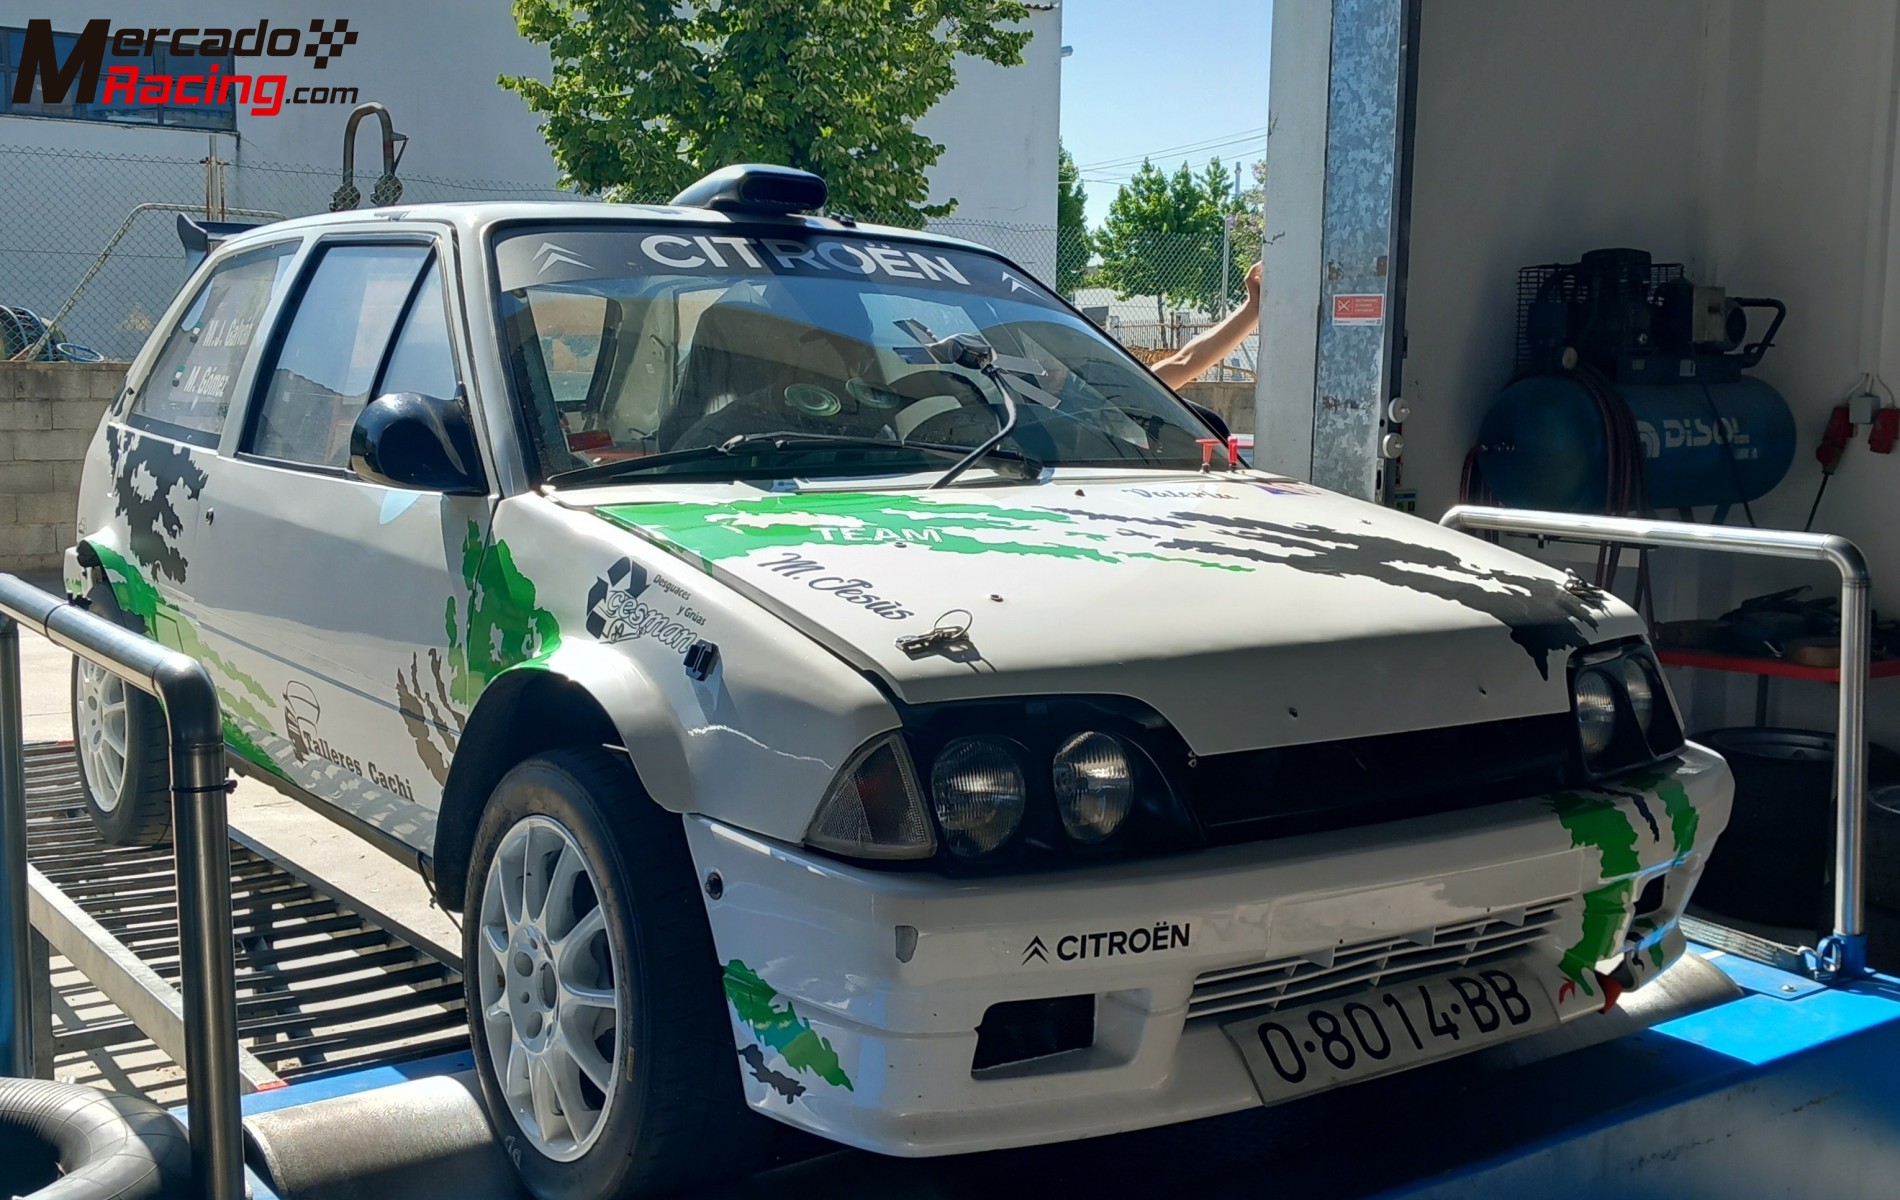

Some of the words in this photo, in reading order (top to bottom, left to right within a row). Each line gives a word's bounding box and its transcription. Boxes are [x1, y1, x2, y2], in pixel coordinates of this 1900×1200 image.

[640, 234, 972, 286] CITROËN
[811, 526, 943, 543] TEAM
[757, 552, 826, 580] M.
[653, 574, 692, 601] Desguaces
[675, 605, 685, 616] y
[303, 731, 363, 778] Talleres
[367, 761, 416, 803] Cachi
[1056, 921, 1190, 961] CITROËN
